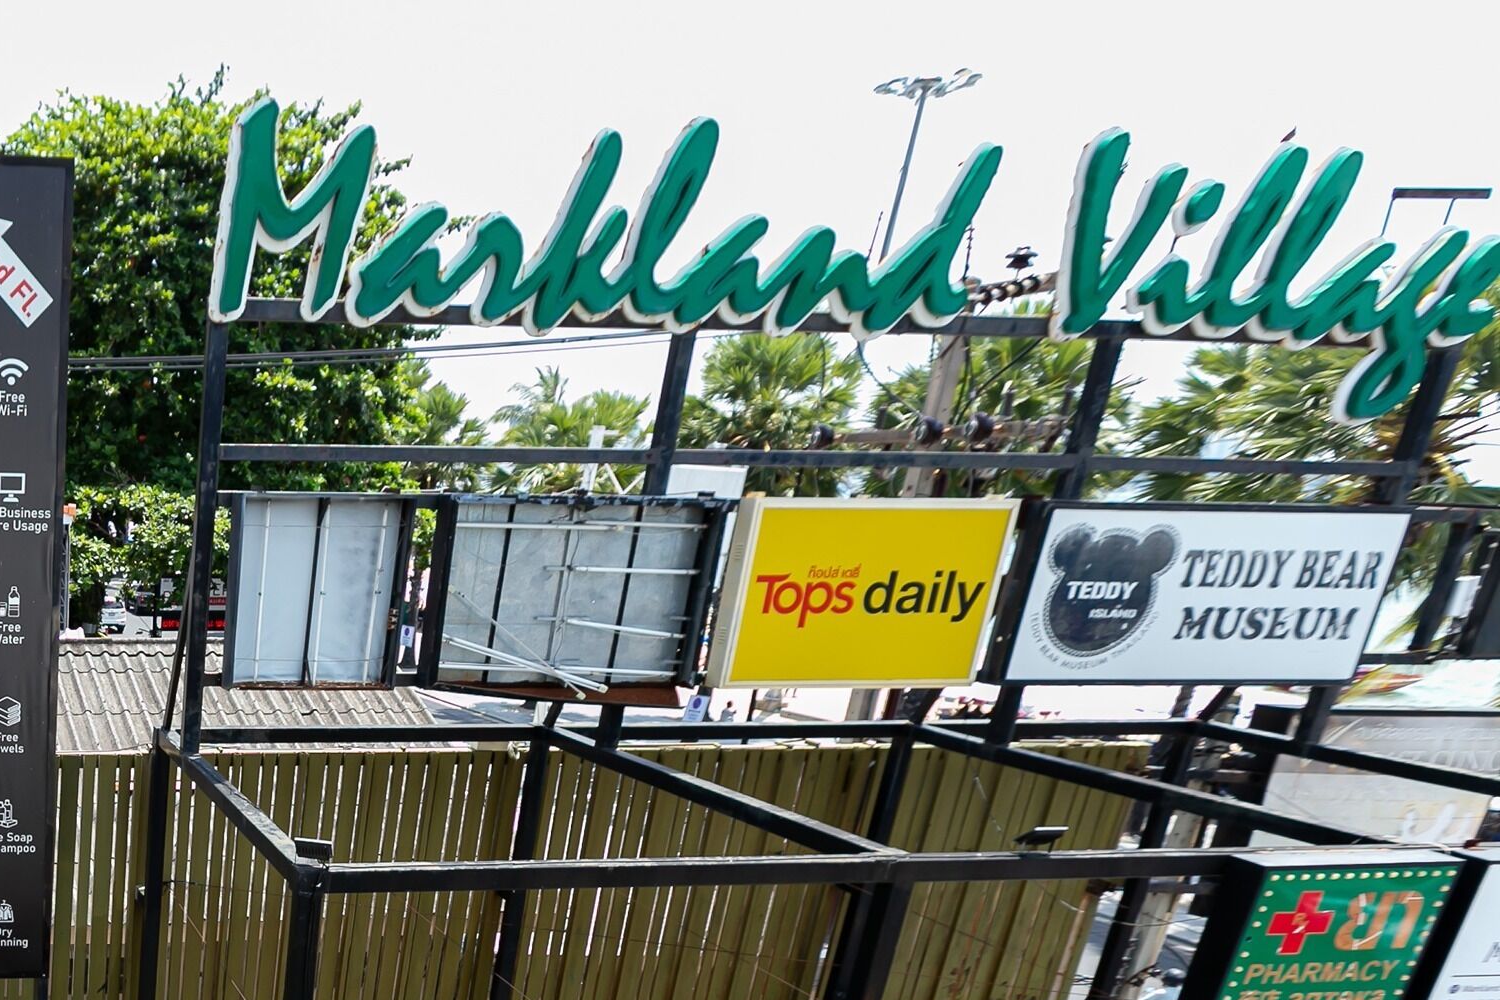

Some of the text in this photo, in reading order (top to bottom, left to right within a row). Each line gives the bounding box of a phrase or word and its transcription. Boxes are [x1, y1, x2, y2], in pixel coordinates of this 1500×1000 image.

[210, 93, 1500, 422] Markland Village
[0, 506, 51, 518] Business
[13, 520, 48, 533] Usage
[1179, 549, 1385, 589] TEDDY BEAR
[756, 569, 988, 629] Tops daily
[1065, 579, 1140, 601] TEDDY
[1172, 606, 1360, 640] MUSEUM
[7, 832, 33, 844] Soap
[1243, 960, 1399, 985] PHARMACY
